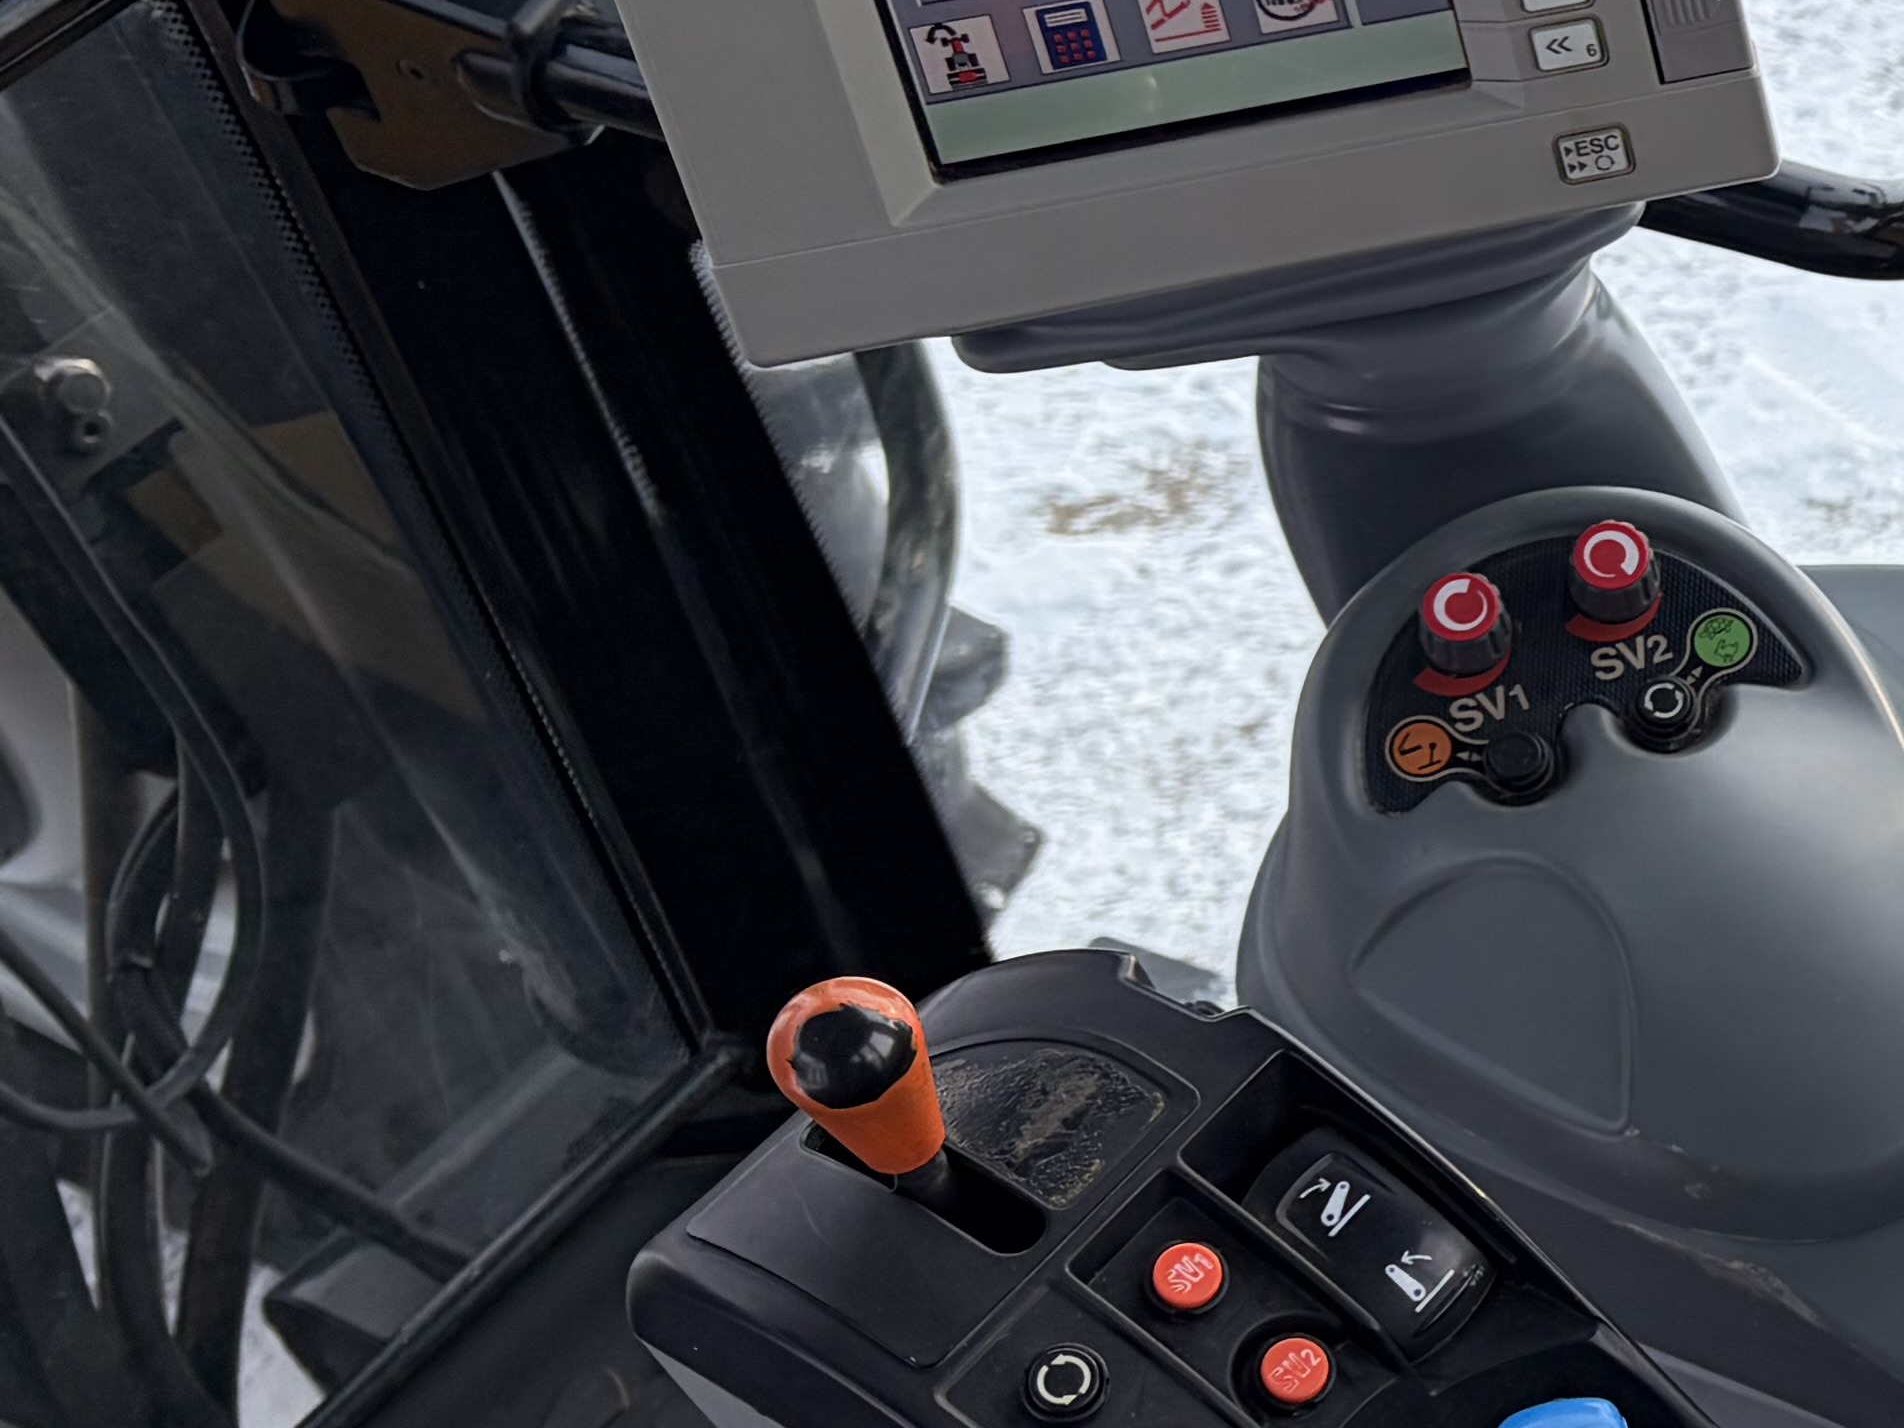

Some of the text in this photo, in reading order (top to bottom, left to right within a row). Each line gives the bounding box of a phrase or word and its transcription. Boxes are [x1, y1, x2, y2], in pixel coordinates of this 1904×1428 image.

[1586, 43, 1597, 58] 6
[1574, 134, 1620, 157] ESC
[1589, 633, 1674, 682] SV2
[1448, 684, 1532, 735] SV1
[1167, 1252, 1215, 1293] SV1
[1270, 1347, 1322, 1392] SV2
